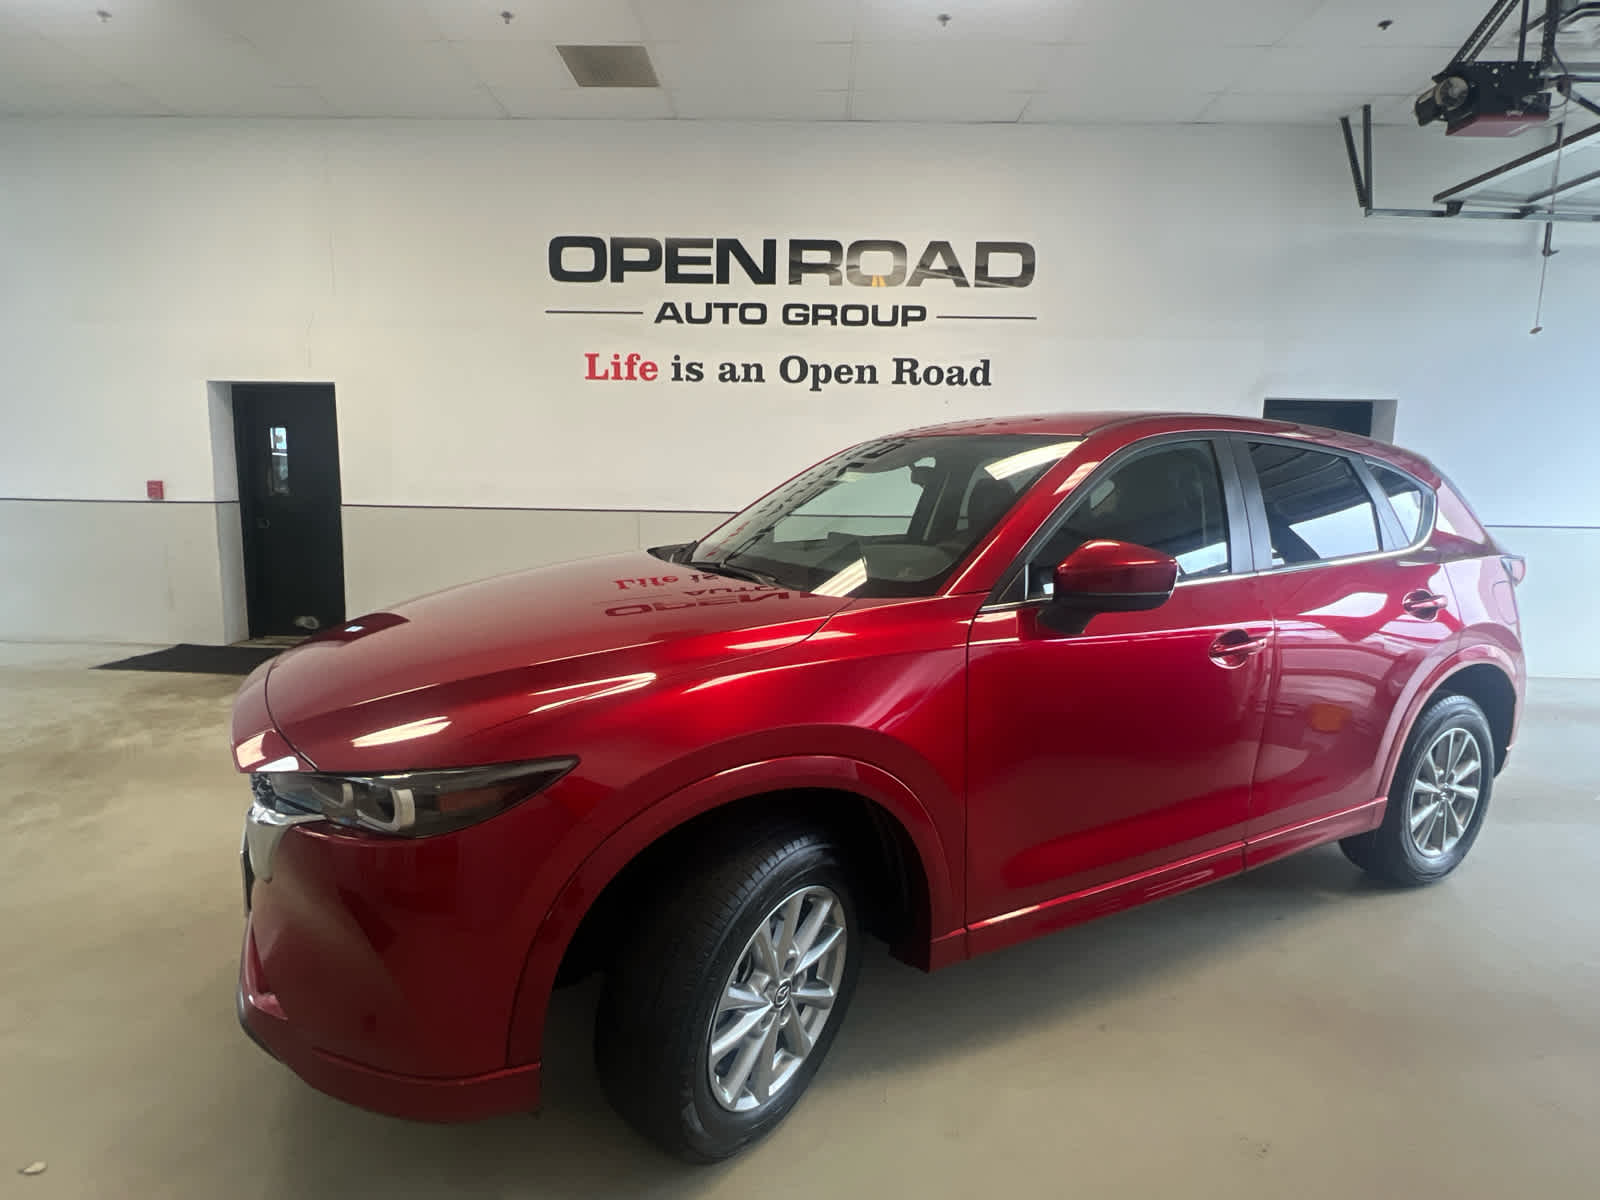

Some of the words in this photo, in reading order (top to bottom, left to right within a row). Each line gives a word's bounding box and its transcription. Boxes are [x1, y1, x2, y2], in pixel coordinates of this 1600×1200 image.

[548, 235, 777, 286] OPEN
[788, 238, 1036, 289] ROAD
[653, 301, 768, 326] AUTO
[781, 302, 927, 328] GROUP
[584, 352, 659, 382] Life
[671, 354, 705, 383] is
[718, 362, 766, 384] an
[779, 355, 879, 392] Open
[891, 357, 992, 387] Road
